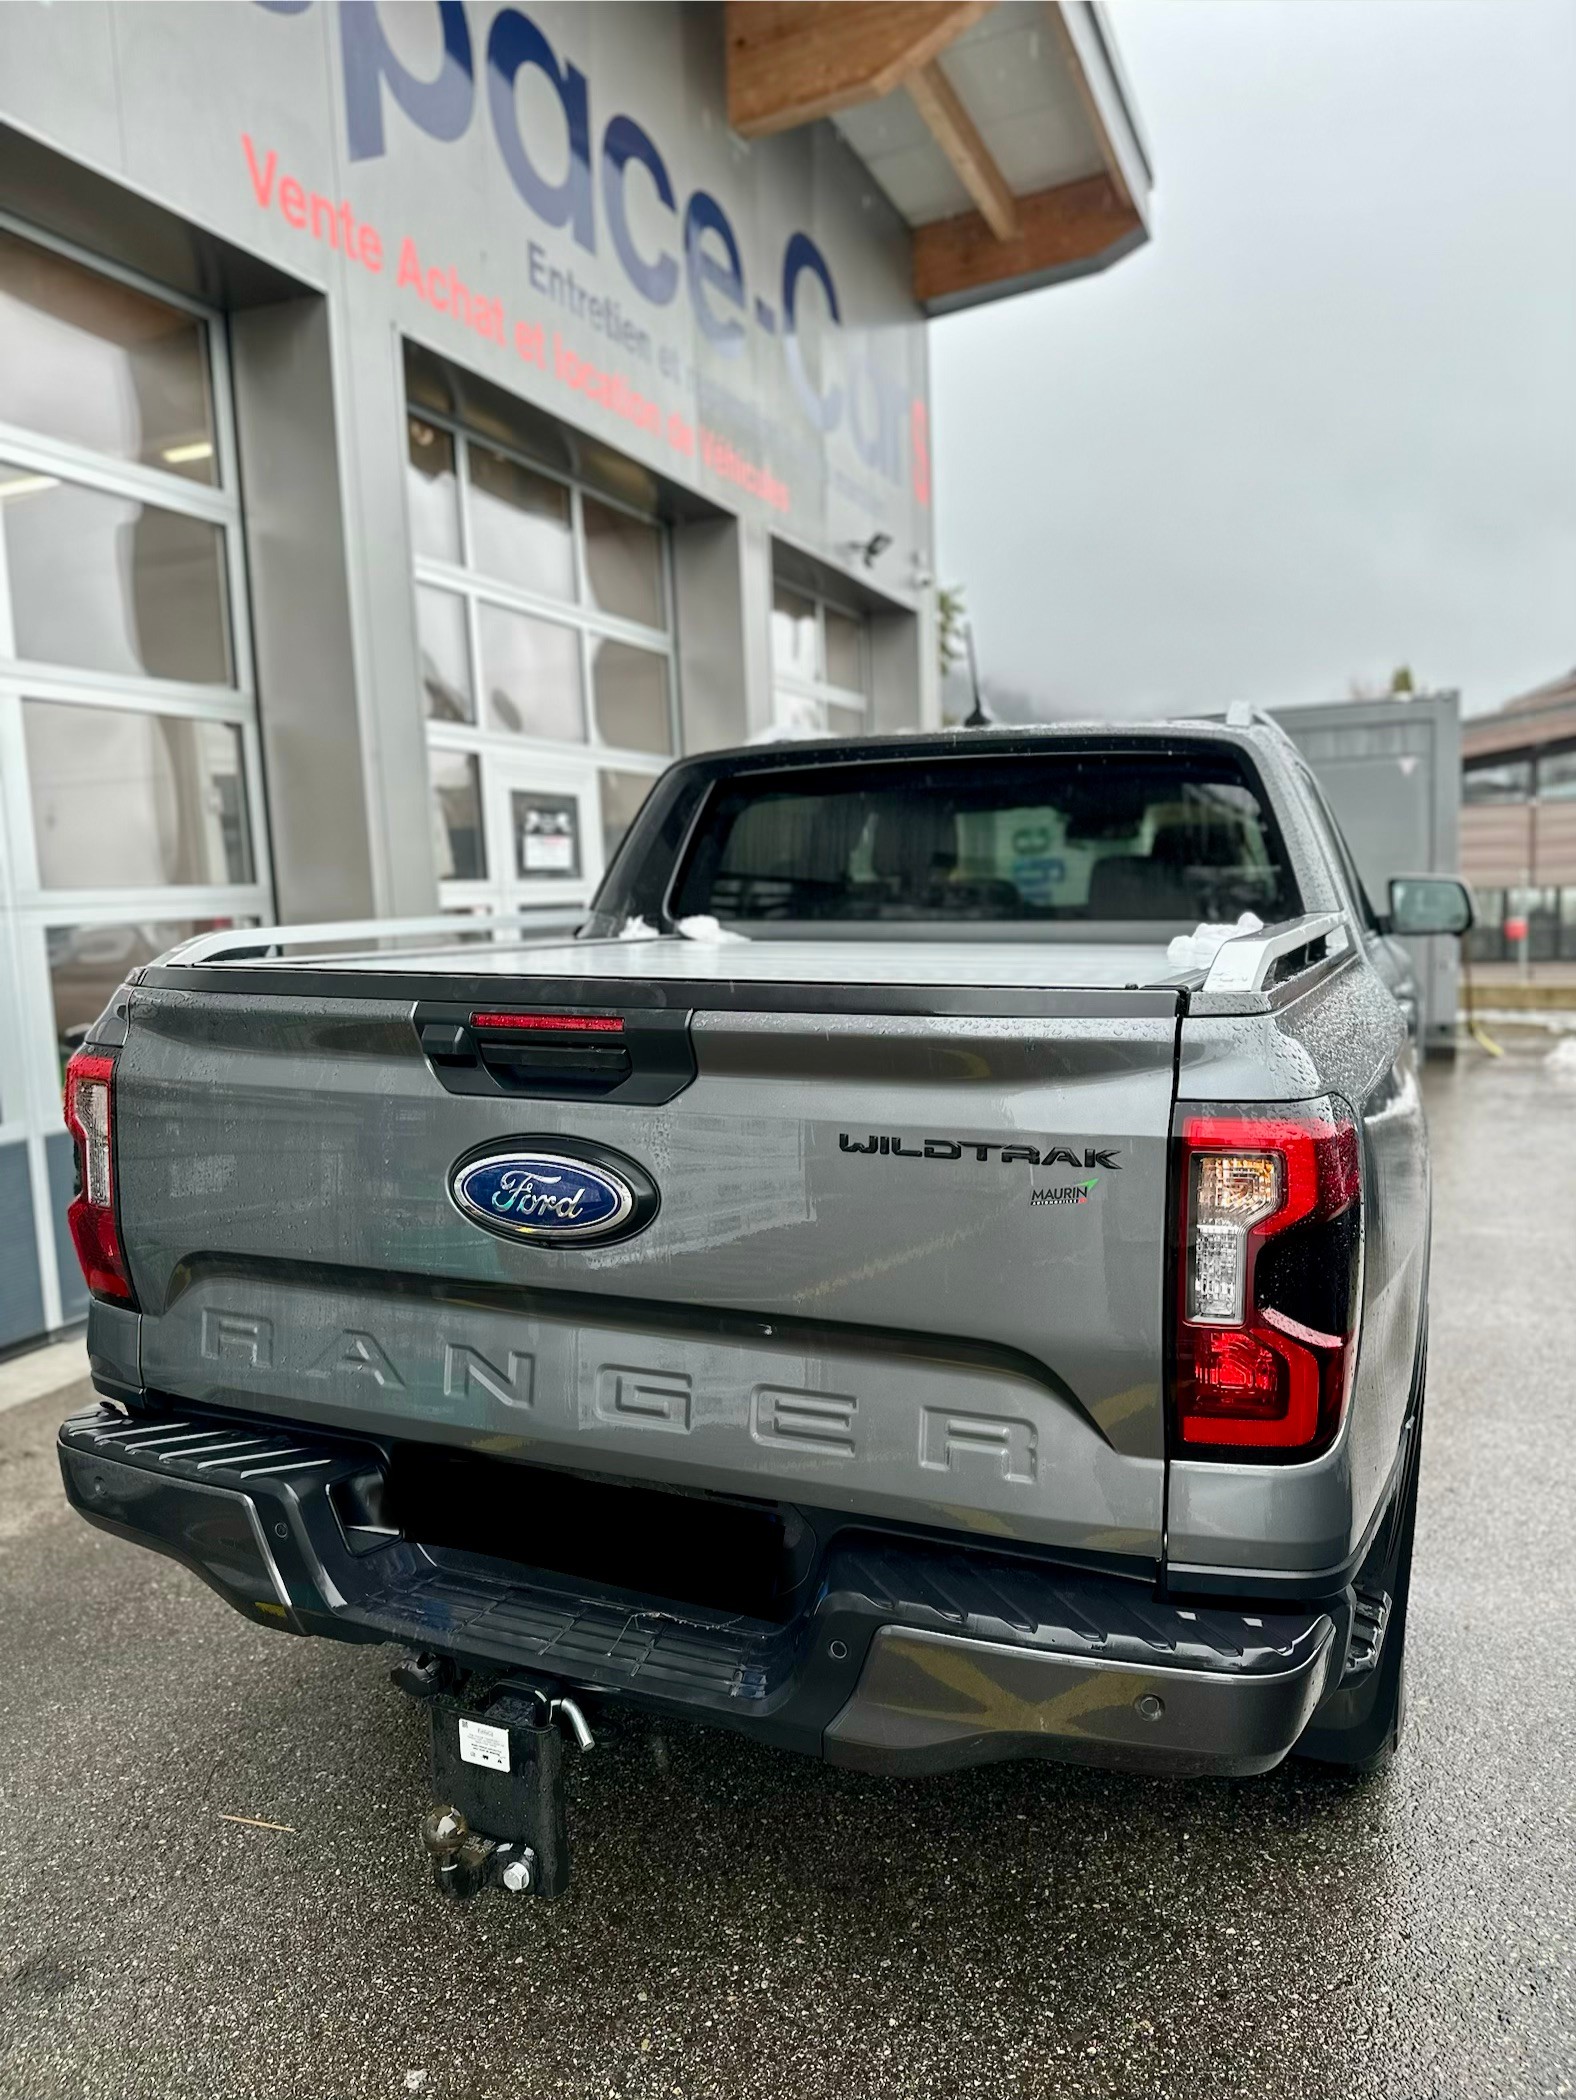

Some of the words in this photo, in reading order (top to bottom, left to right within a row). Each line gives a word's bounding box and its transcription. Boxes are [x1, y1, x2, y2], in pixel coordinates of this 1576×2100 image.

[239, 131, 384, 276] Vente
[395, 235, 508, 348] Achat
[514, 319, 547, 371] et
[552, 331, 662, 436] location
[527, 239, 652, 363] Entretien
[491, 1170, 587, 1219] Ford
[838, 1133, 1123, 1170] WILDTRAK
[1031, 1186, 1088, 1201] MAURIN
[201, 1305, 1040, 1485] RANGER
